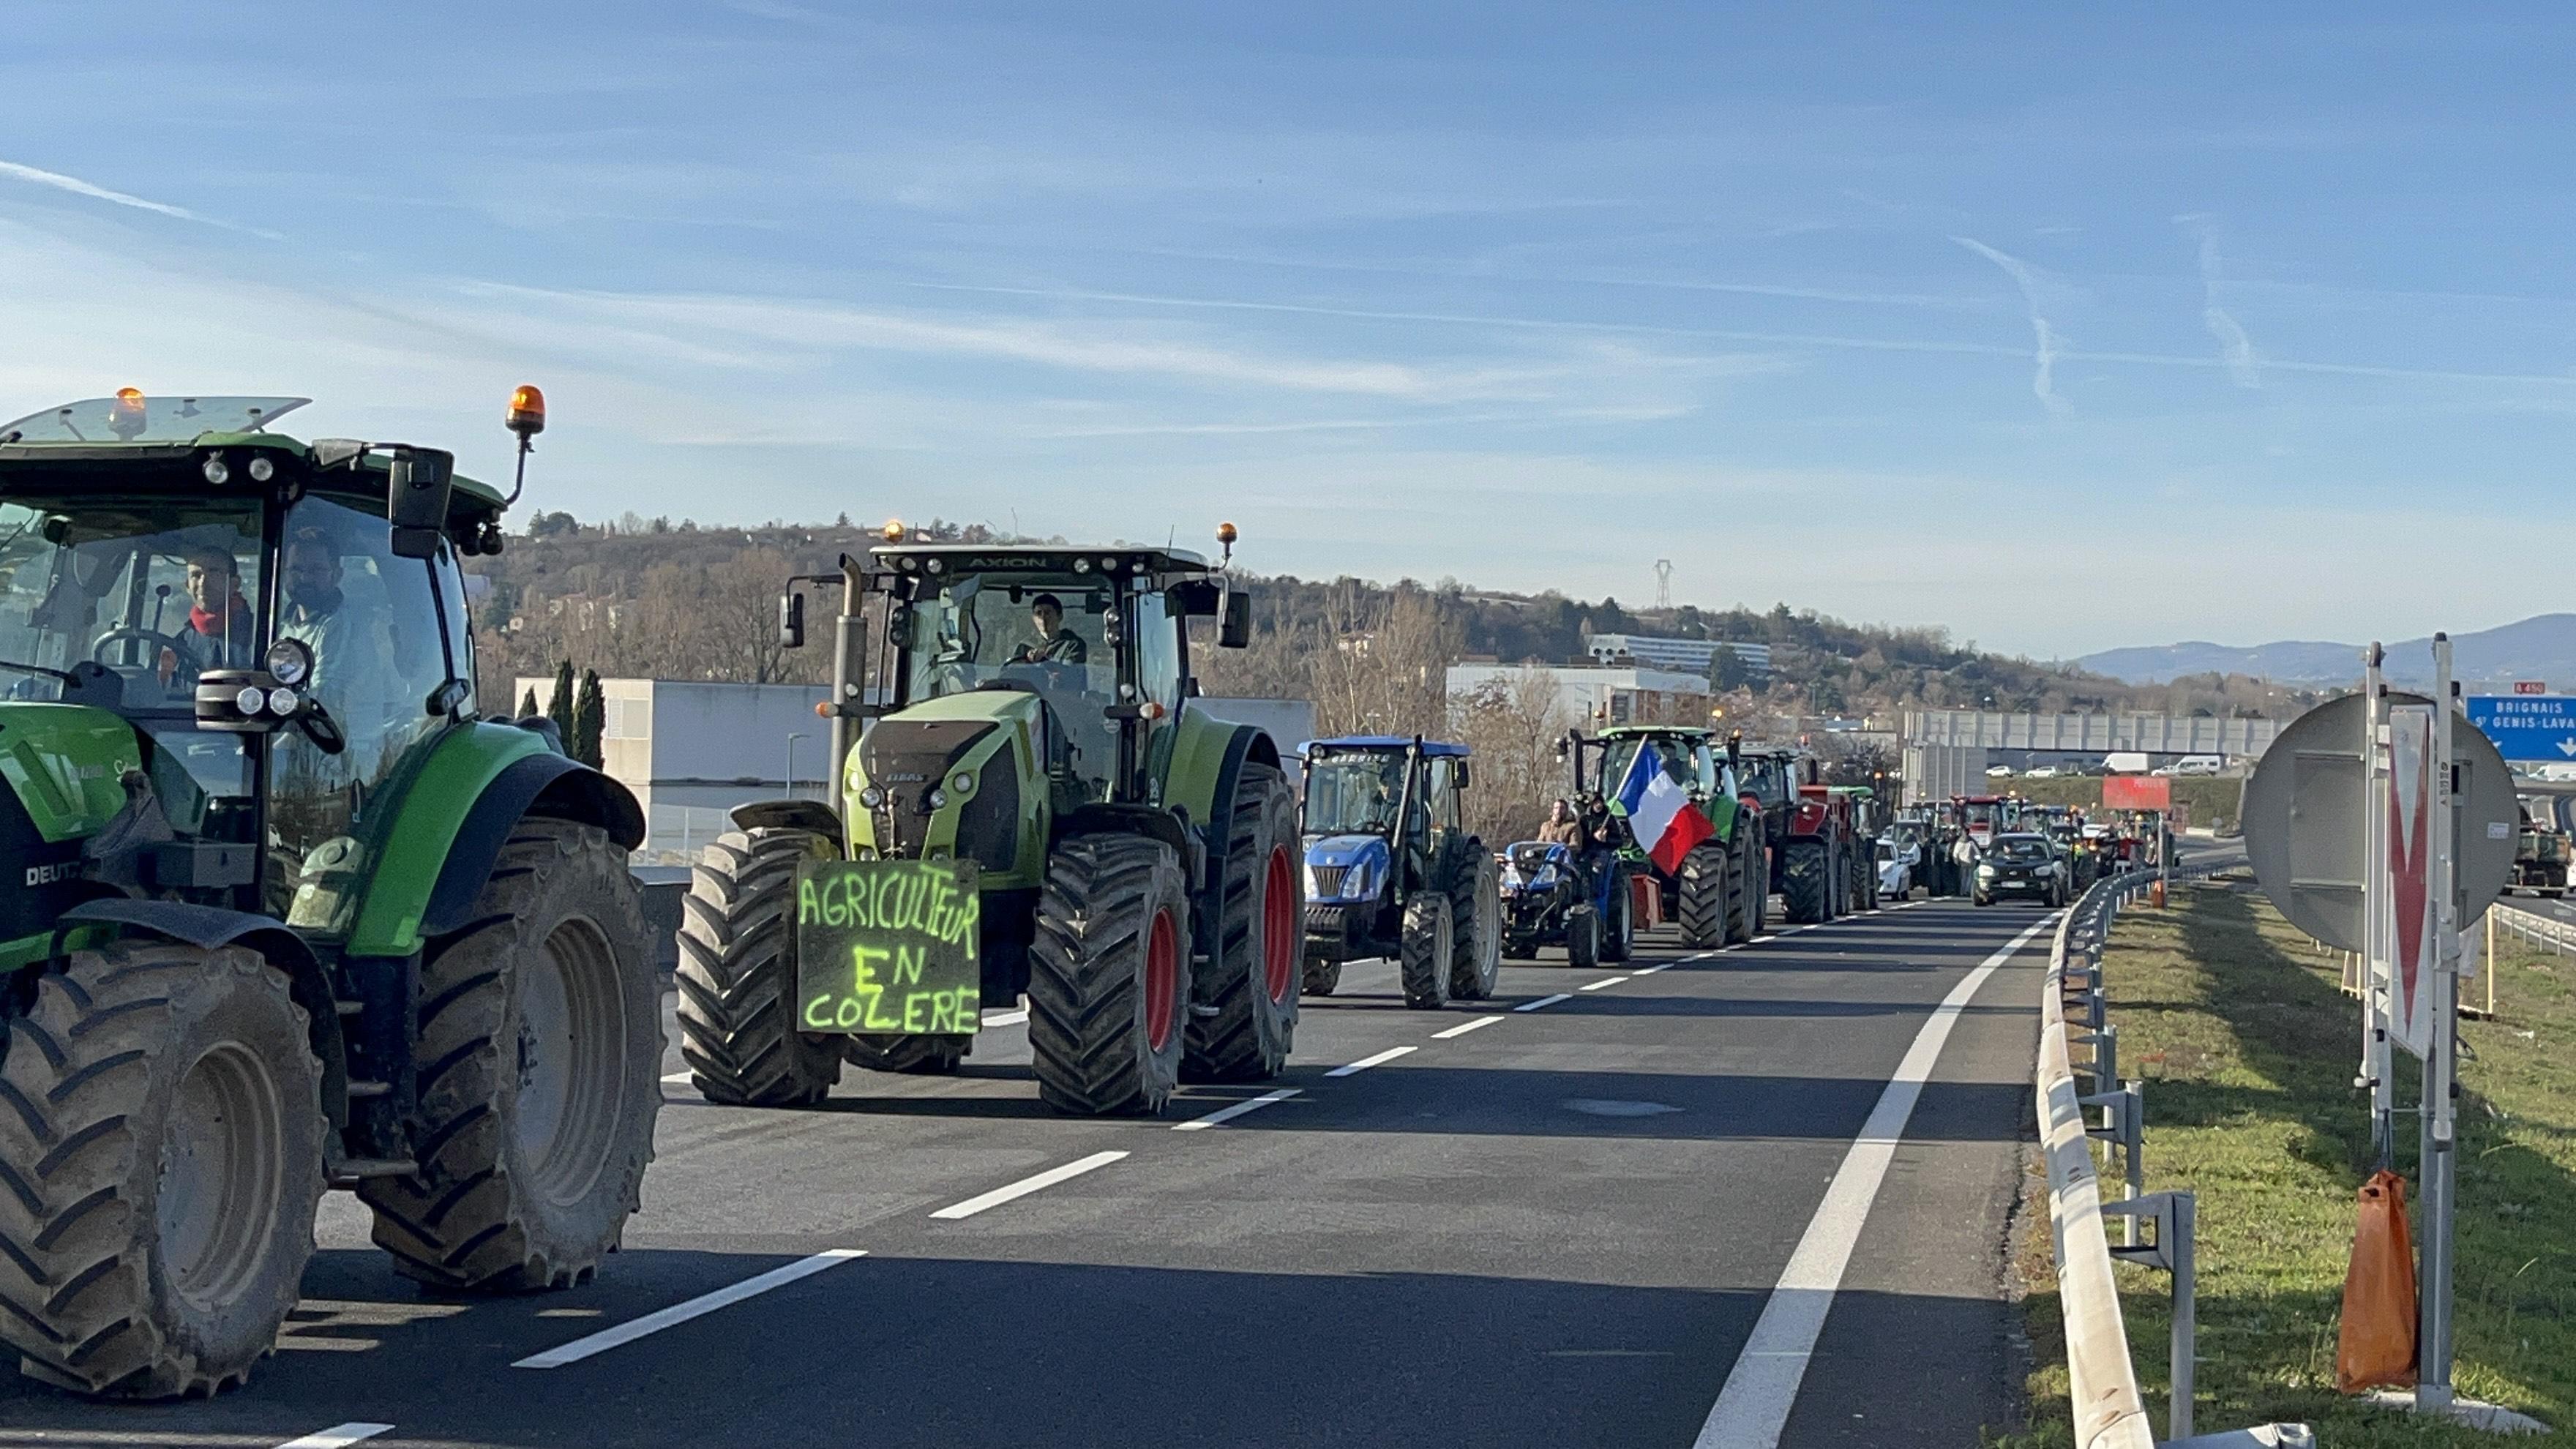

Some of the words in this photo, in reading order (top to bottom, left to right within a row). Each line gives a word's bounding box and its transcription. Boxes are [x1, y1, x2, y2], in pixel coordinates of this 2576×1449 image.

[969, 558, 1046, 567] AXION
[2496, 701, 2563, 714] BRIGNAIS
[799, 862, 979, 960] AGRICULTEUR
[853, 944, 926, 995] EN
